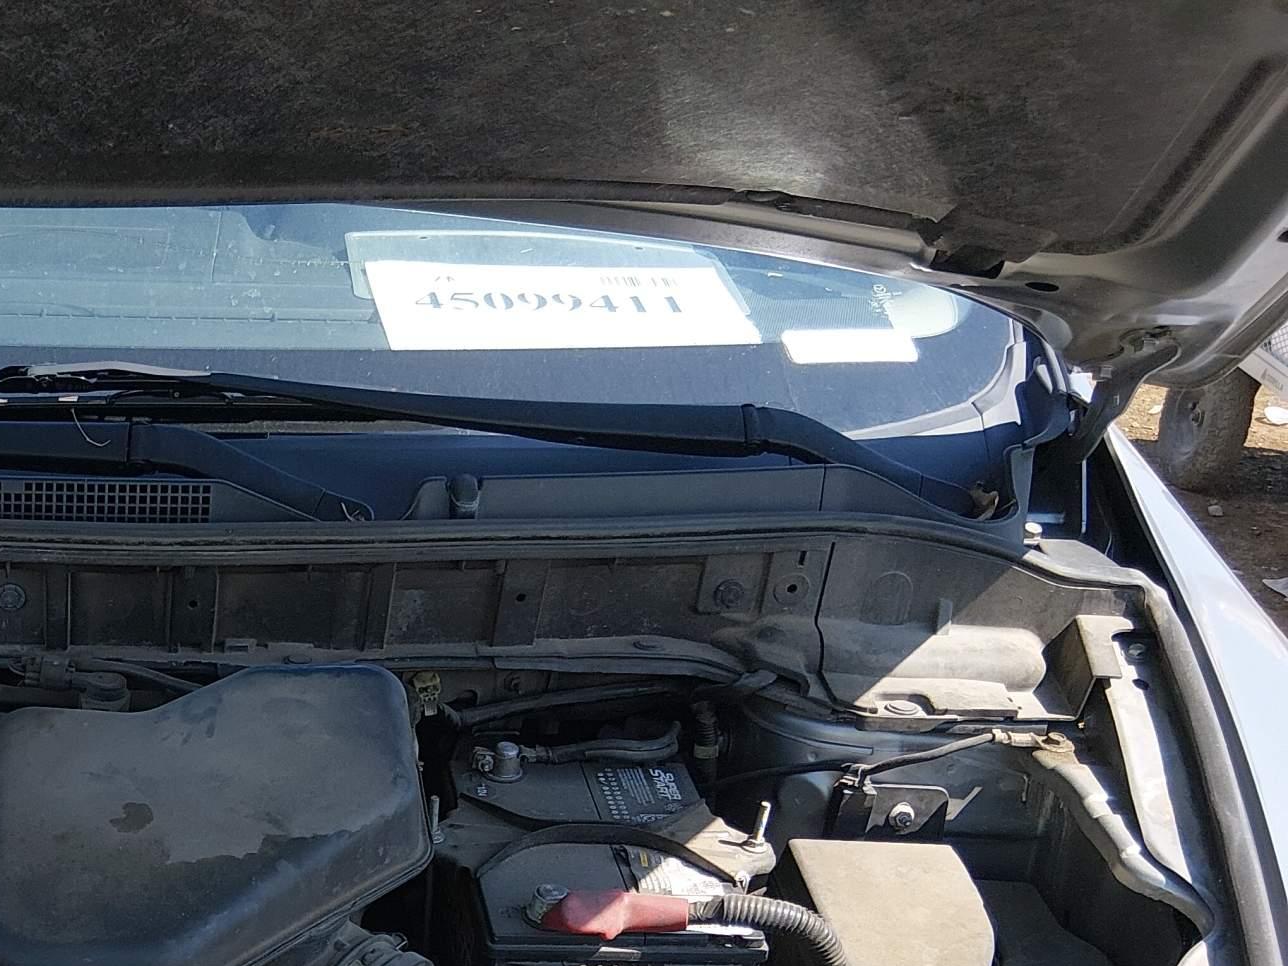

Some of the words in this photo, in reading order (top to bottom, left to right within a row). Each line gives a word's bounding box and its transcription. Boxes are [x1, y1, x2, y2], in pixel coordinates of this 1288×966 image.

[414, 290, 683, 313] 45099411
[648, 768, 672, 800] START
[664, 772, 682, 800] SUPER
